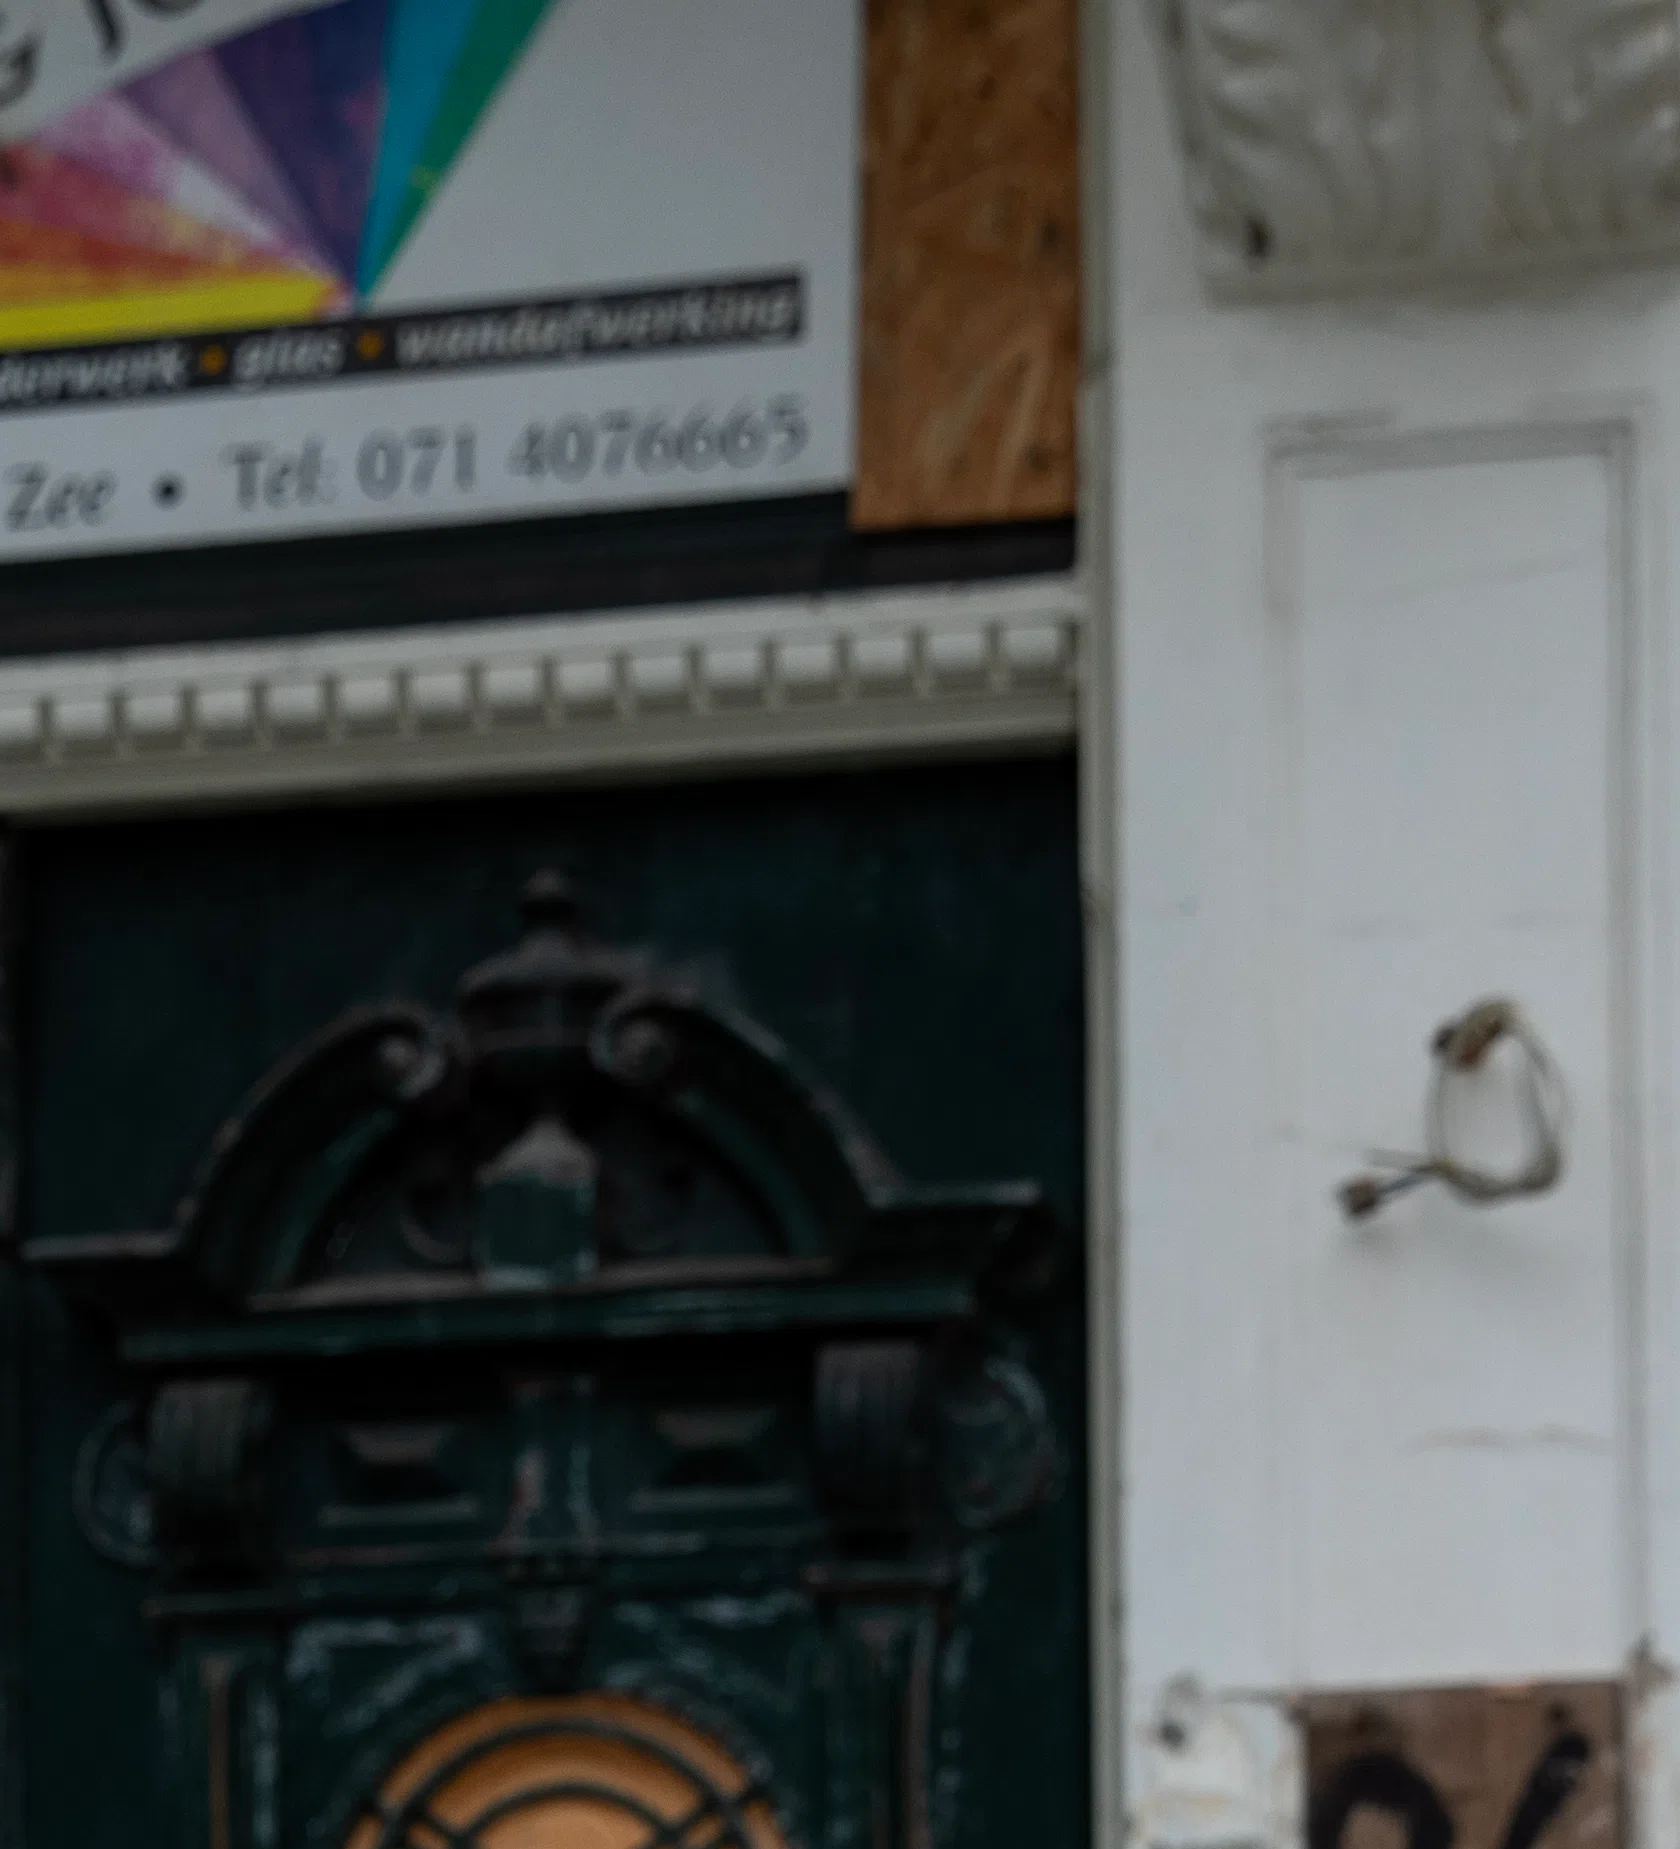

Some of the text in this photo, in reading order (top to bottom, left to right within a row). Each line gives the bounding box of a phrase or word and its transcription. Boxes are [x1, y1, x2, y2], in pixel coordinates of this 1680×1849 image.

[233, 325, 340, 390] glas
[395, 286, 798, 362] wandafwerking
[2, 462, 117, 532] Zee
[353, 424, 478, 502] 071
[508, 395, 810, 484] 4076665
